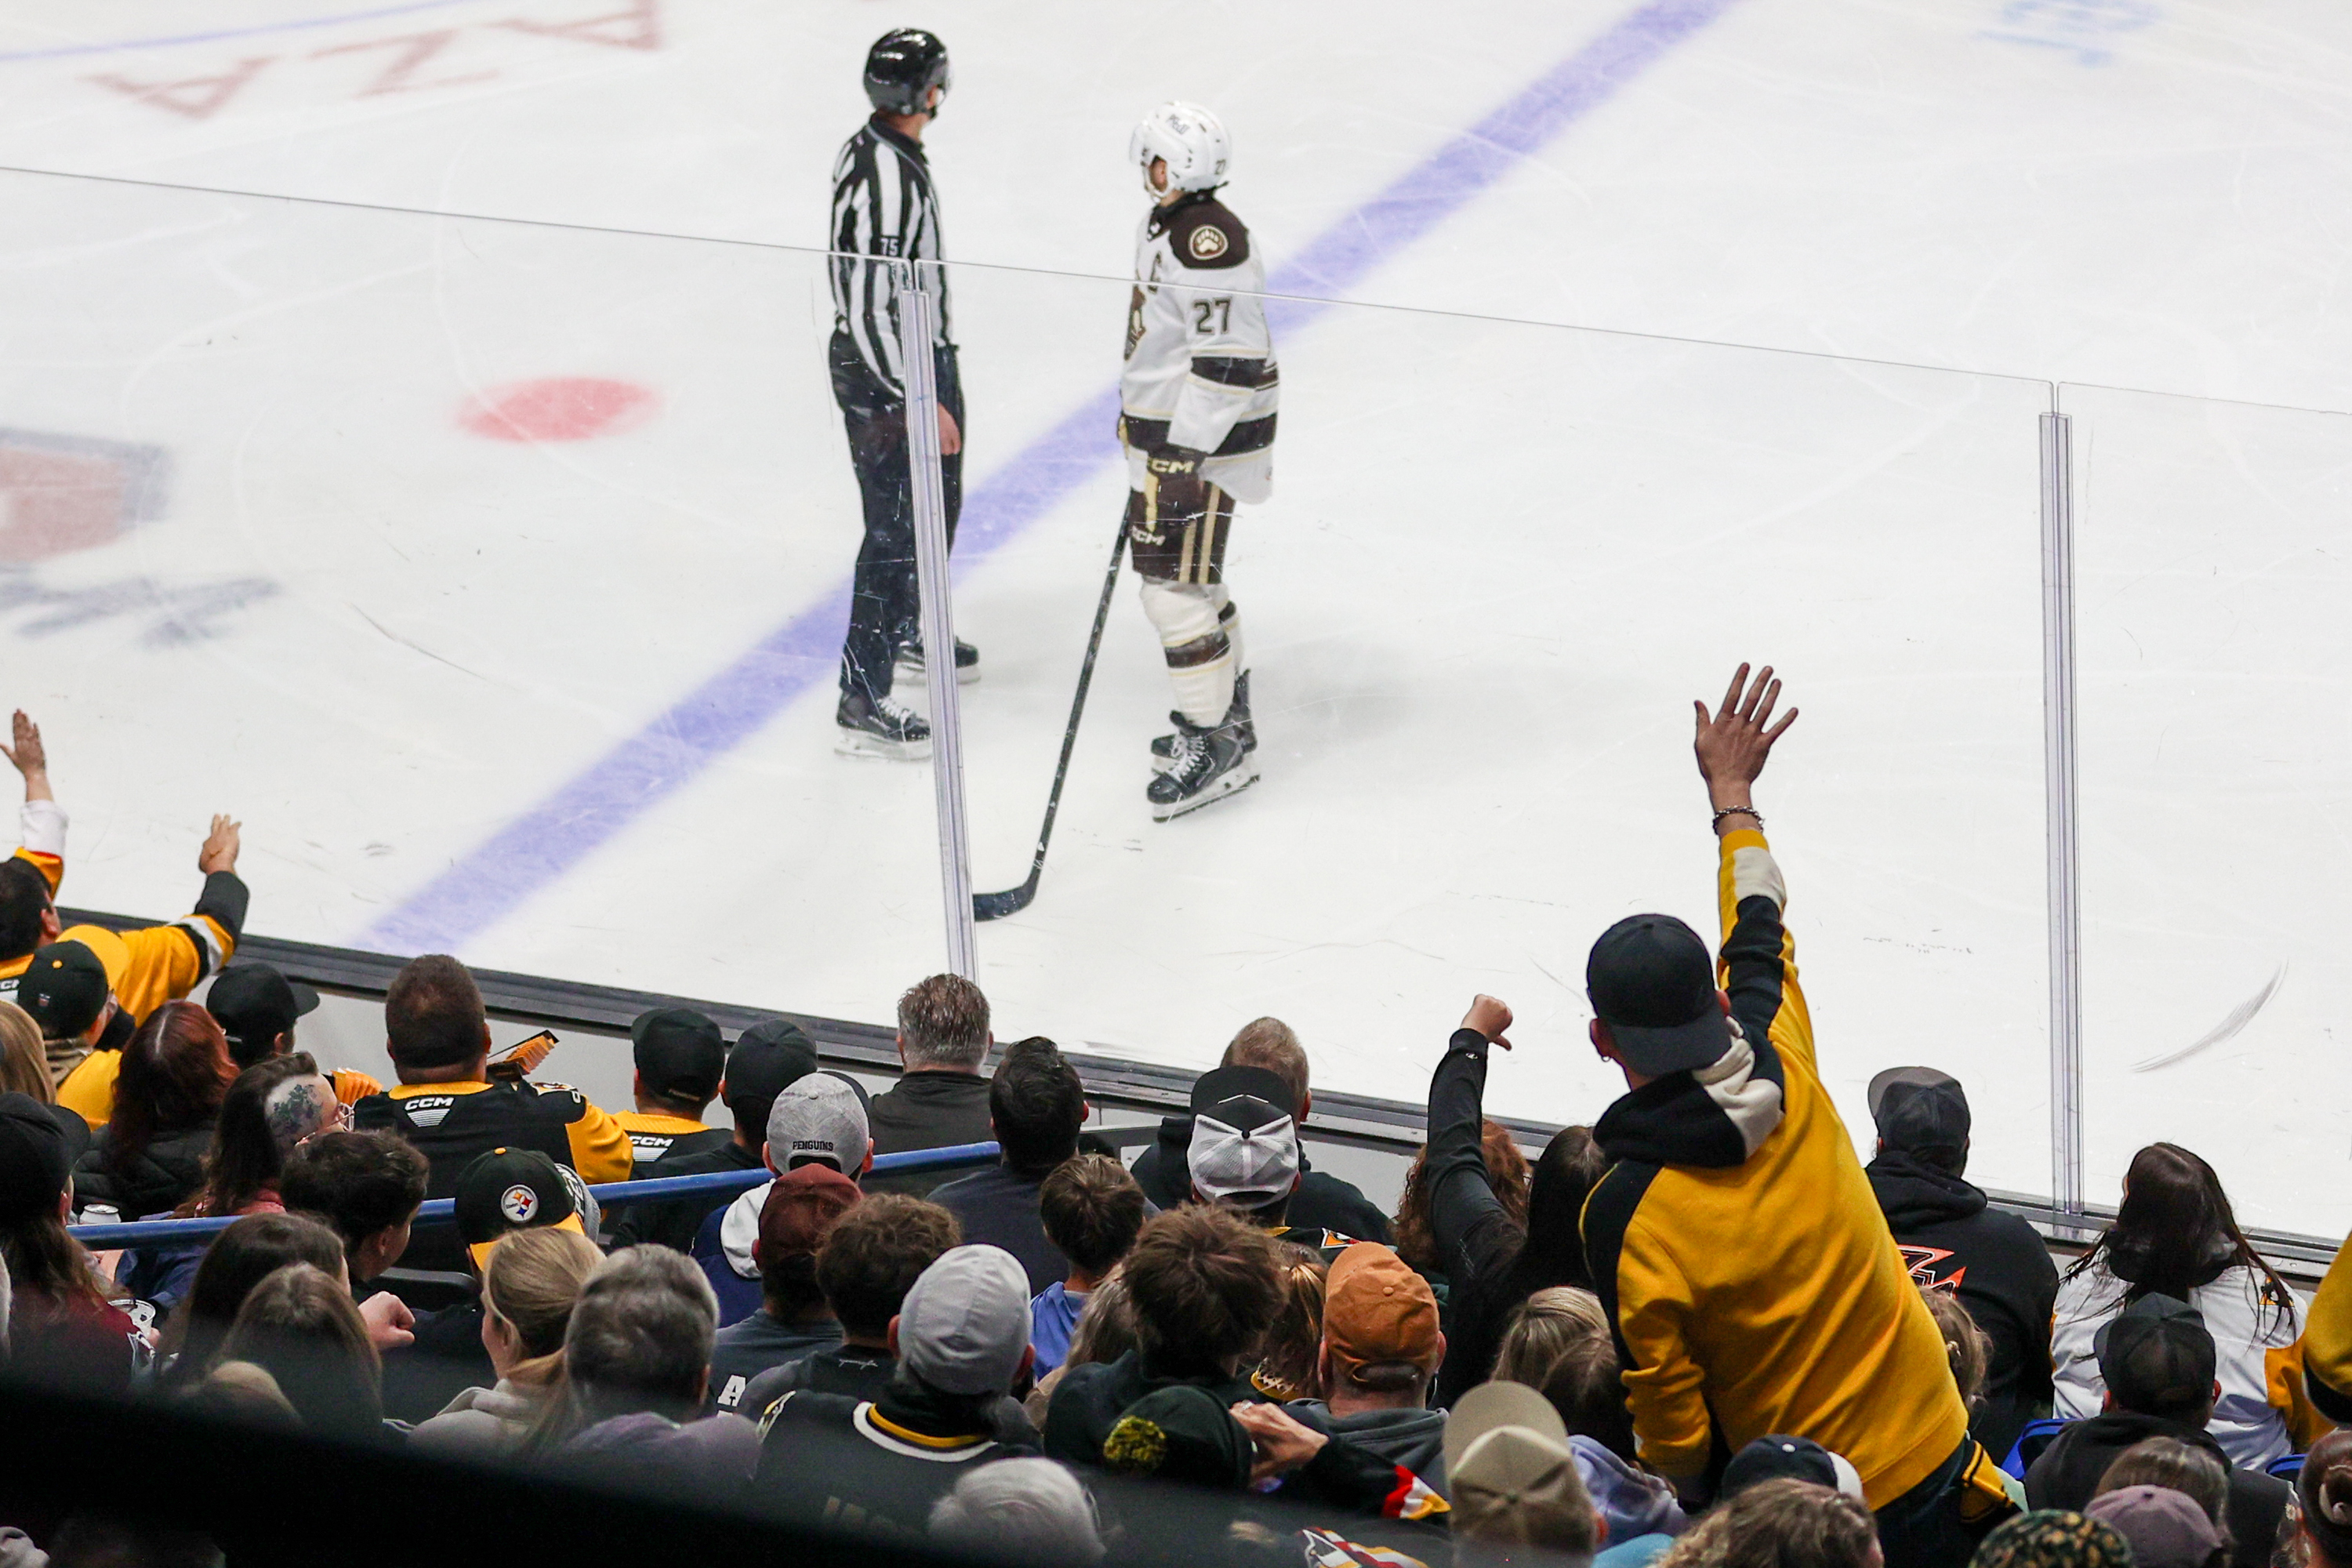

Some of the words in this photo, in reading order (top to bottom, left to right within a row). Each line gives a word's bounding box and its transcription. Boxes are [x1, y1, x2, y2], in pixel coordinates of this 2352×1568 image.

[880, 237, 899, 256] 75
[1193, 295, 1233, 336] 27
[1150, 458, 1196, 474] CM
[404, 1097, 455, 1111] CCM
[628, 1135, 674, 1147] CCM
[792, 1141, 833, 1152] PENGUINS
